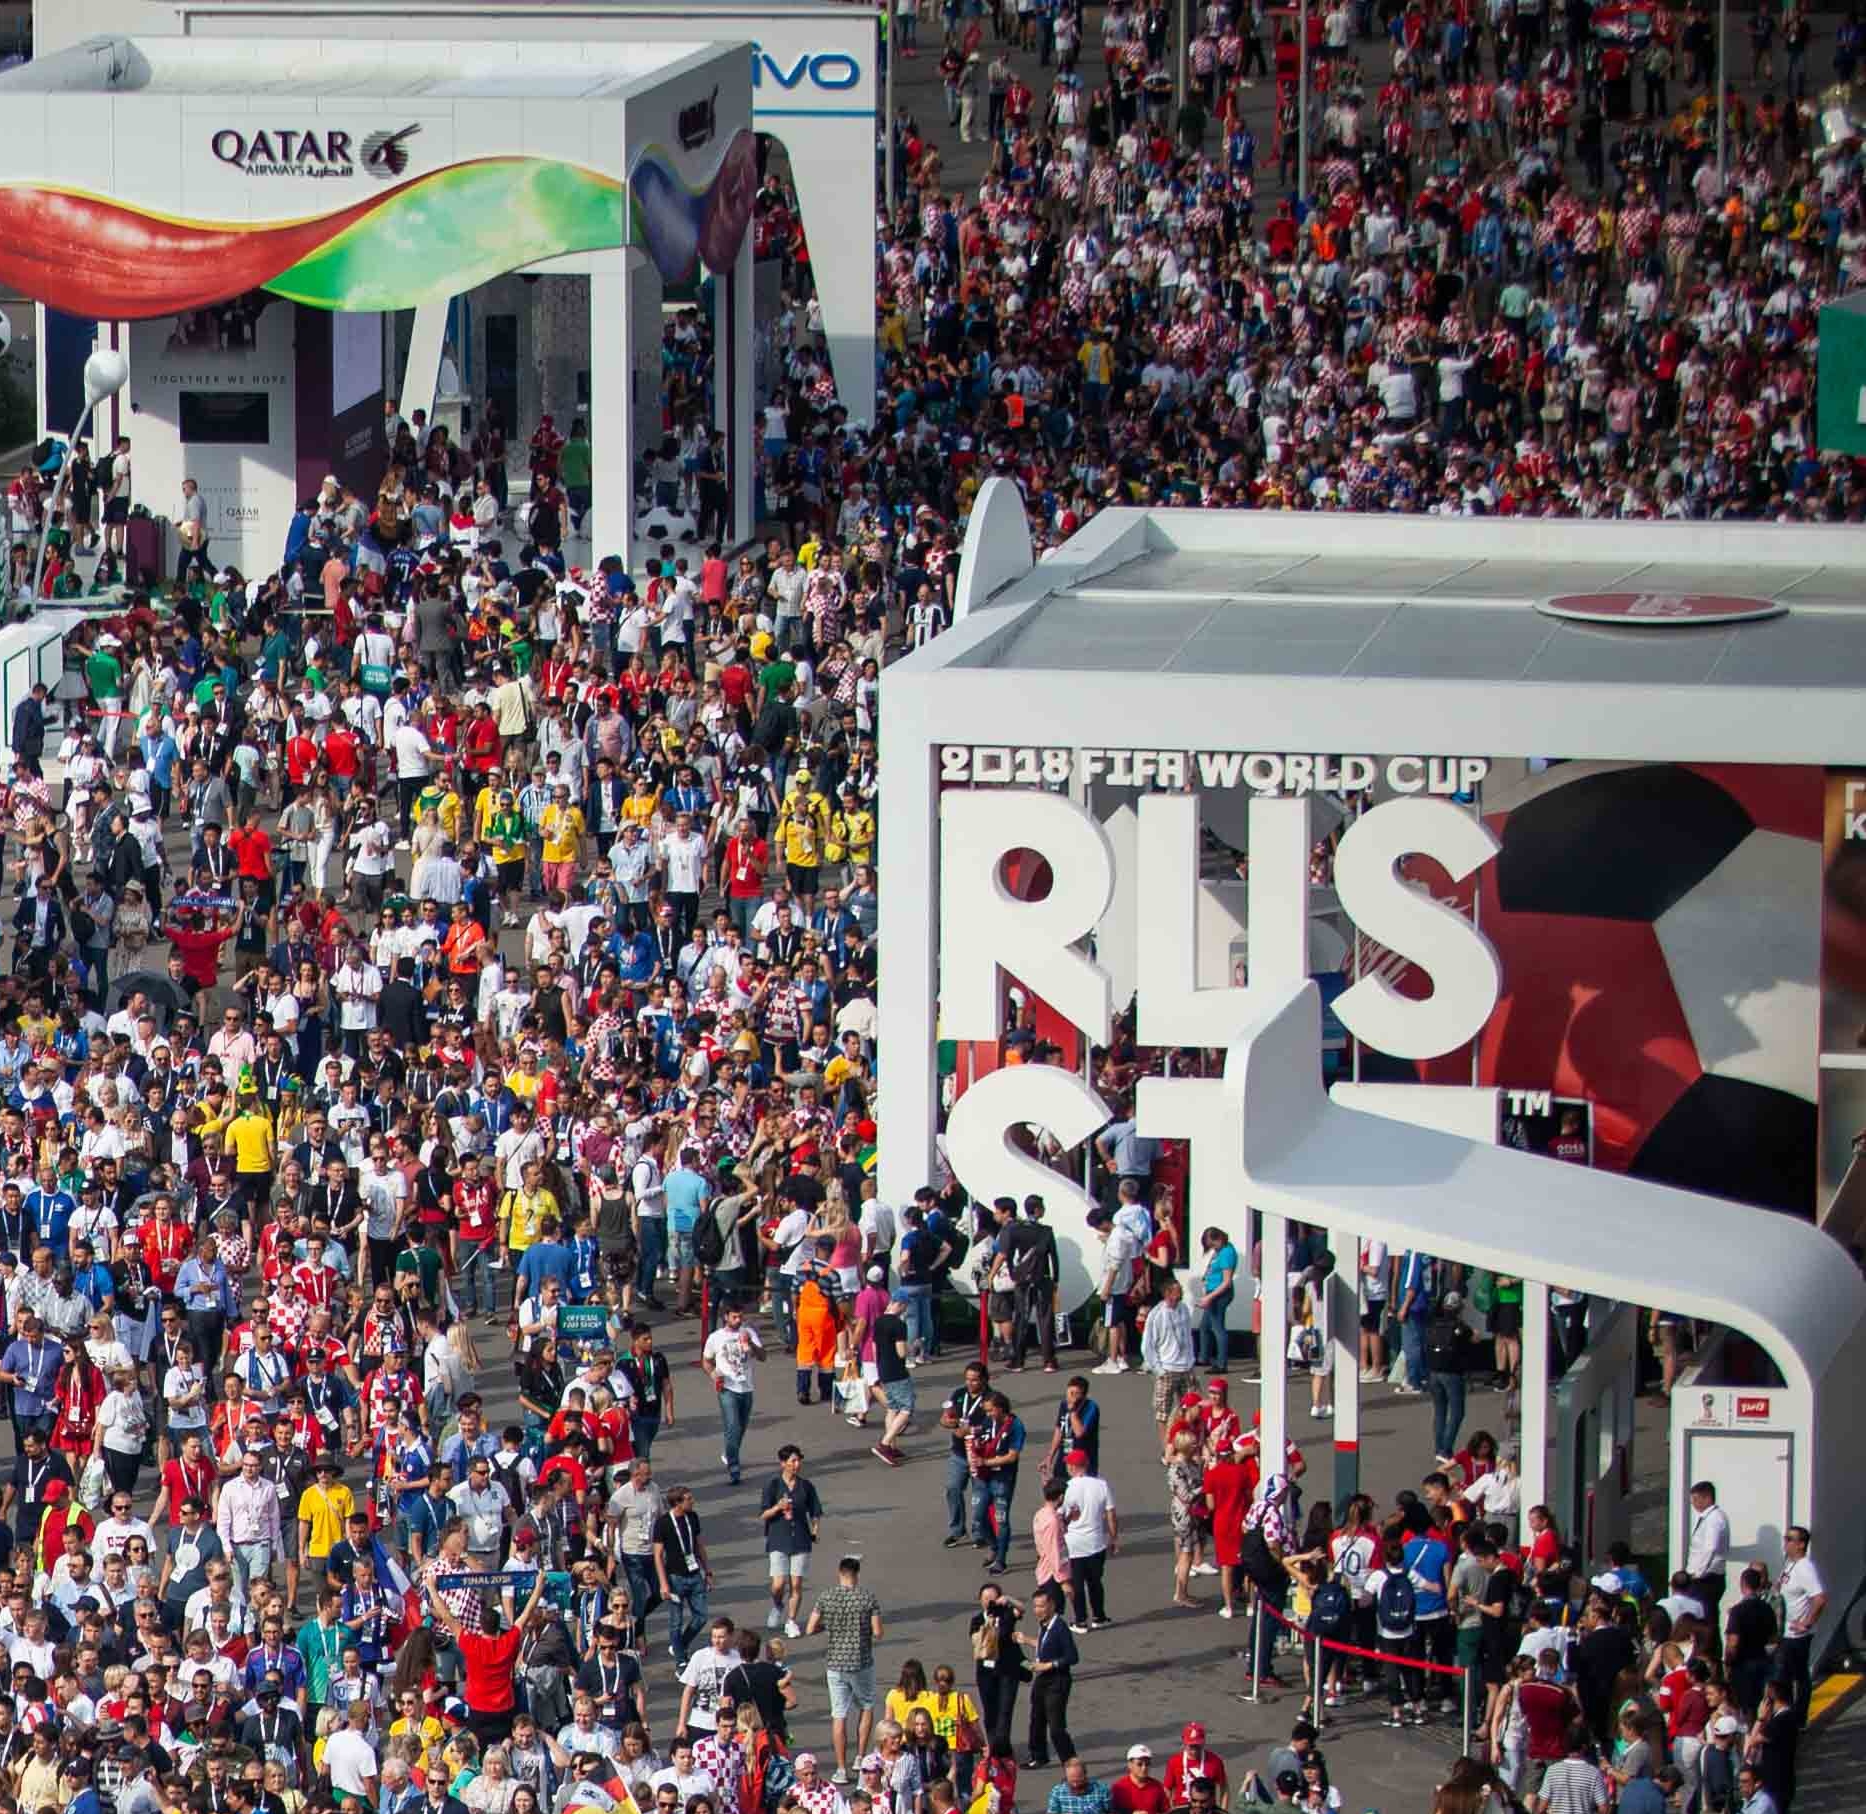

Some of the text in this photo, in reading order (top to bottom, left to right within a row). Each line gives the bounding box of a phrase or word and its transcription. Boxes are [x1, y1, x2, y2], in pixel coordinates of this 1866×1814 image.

[752, 39, 861, 90] ivo
[211, 129, 353, 169] QATAR
[245, 165, 304, 178] AIRWAYS
[940, 746, 1490, 794] 2018 FIFA WORLD CUP
[939, 790, 1504, 1062] RUS
